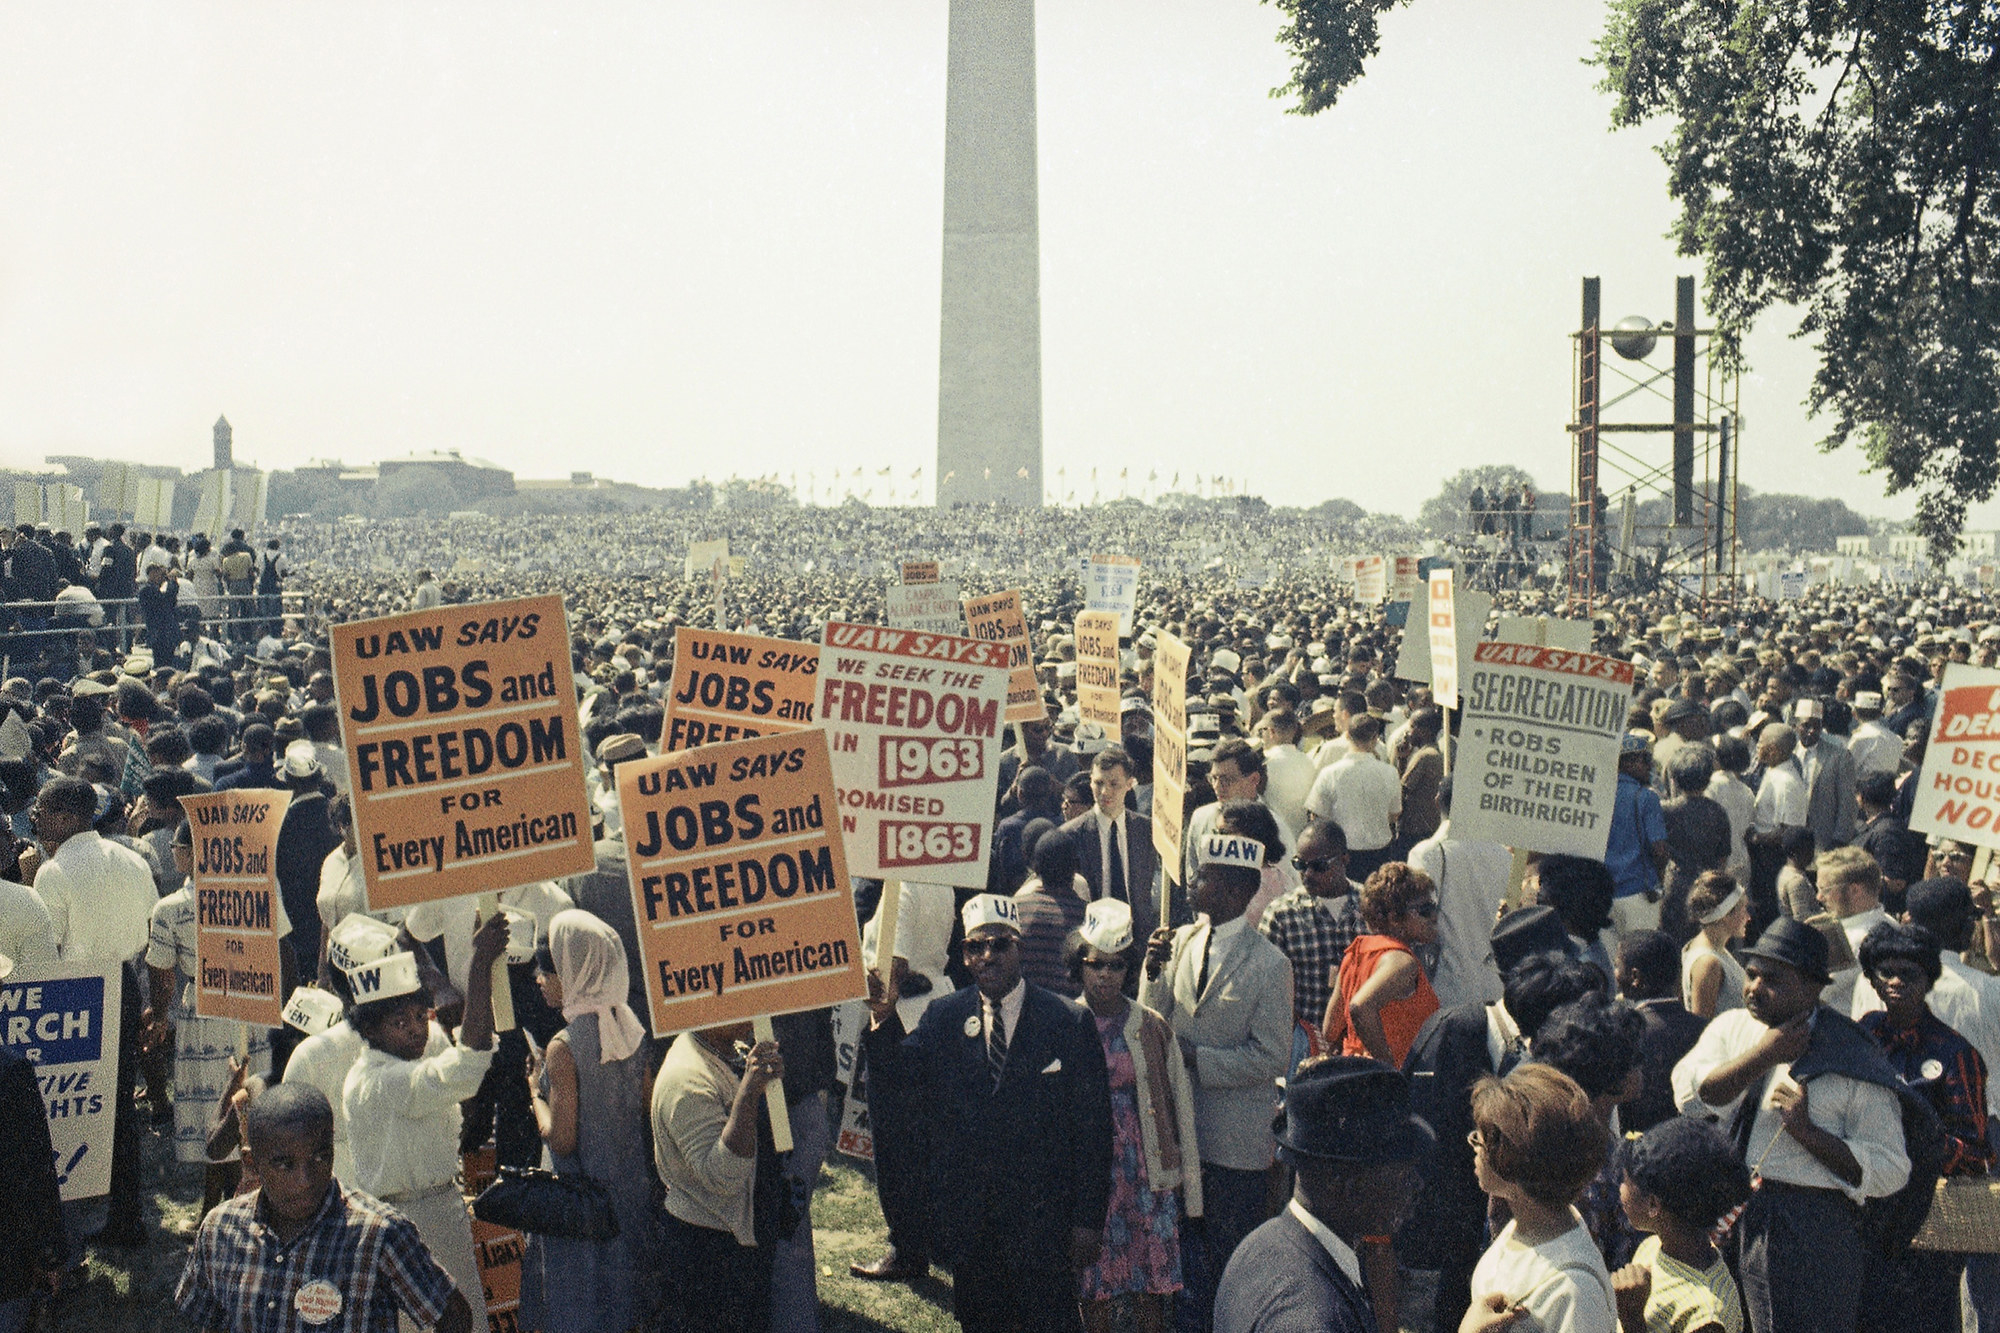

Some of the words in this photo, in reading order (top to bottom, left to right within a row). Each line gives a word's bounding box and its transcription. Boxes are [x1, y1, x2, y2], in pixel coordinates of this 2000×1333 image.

[970, 603, 990, 617] UAW
[993, 597, 1014, 612] SAYS
[355, 625, 444, 659] UAW
[456, 613, 541, 647] SAYS
[832, 624, 905, 651] UAW
[909, 634, 1005, 665] SAYS:
[974, 619, 1005, 640] JOBS
[1007, 620, 1023, 638] and
[1078, 635, 1101, 657] JOBS
[1103, 643, 1115, 659] and
[692, 641, 752, 665] UAW
[758, 651, 819, 675] SAYS
[836, 657, 867, 675] WE
[875, 663, 935, 685] SEEK
[942, 671, 985, 690] THE
[1079, 663, 1117, 689] FREEDOM
[1480, 643, 1538, 664] UAW
[1543, 652, 1631, 680] SAYS:
[350, 660, 493, 723] JOBS
[500, 661, 556, 701] and
[676, 670, 775, 715] JOBS
[821, 678, 999, 738] FREEDOM
[1470, 672, 1626, 733] SEGREGATION
[357, 716, 566, 791] FREEDOM
[833, 731, 858, 753] IN
[1490, 728, 1561, 755] ROBS
[638, 762, 717, 796] UAW
[729, 748, 806, 782] SAYS
[885, 739, 981, 782] 1963
[1486, 750, 1596, 784] CHILDREN
[441, 789, 503, 814] FOR
[1484, 772, 1513, 790] OF
[1524, 778, 1594, 807] THEIR
[197, 805, 229, 825] UAW
[232, 802, 270, 824] SAYS
[636, 794, 764, 857] JOBS
[771, 794, 823, 834] and
[1480, 793, 1600, 830] BIRTHRIGHT
[1935, 799, 2000, 833] NO
[199, 835, 244, 874] JOBS
[246, 845, 268, 874] and
[373, 832, 445, 873] Every
[455, 811, 577, 859] American
[887, 823, 974, 860] 1863
[1208, 838, 1259, 861] UAW
[641, 846, 836, 921] FREEDOM
[199, 889, 270, 928] FREEDOM
[226, 939, 244, 954] FOR
[720, 917, 776, 942] FOR
[202, 957, 227, 996] Every
[228, 961, 274, 995] American
[658, 959, 724, 996] Every
[733, 939, 849, 983] American
